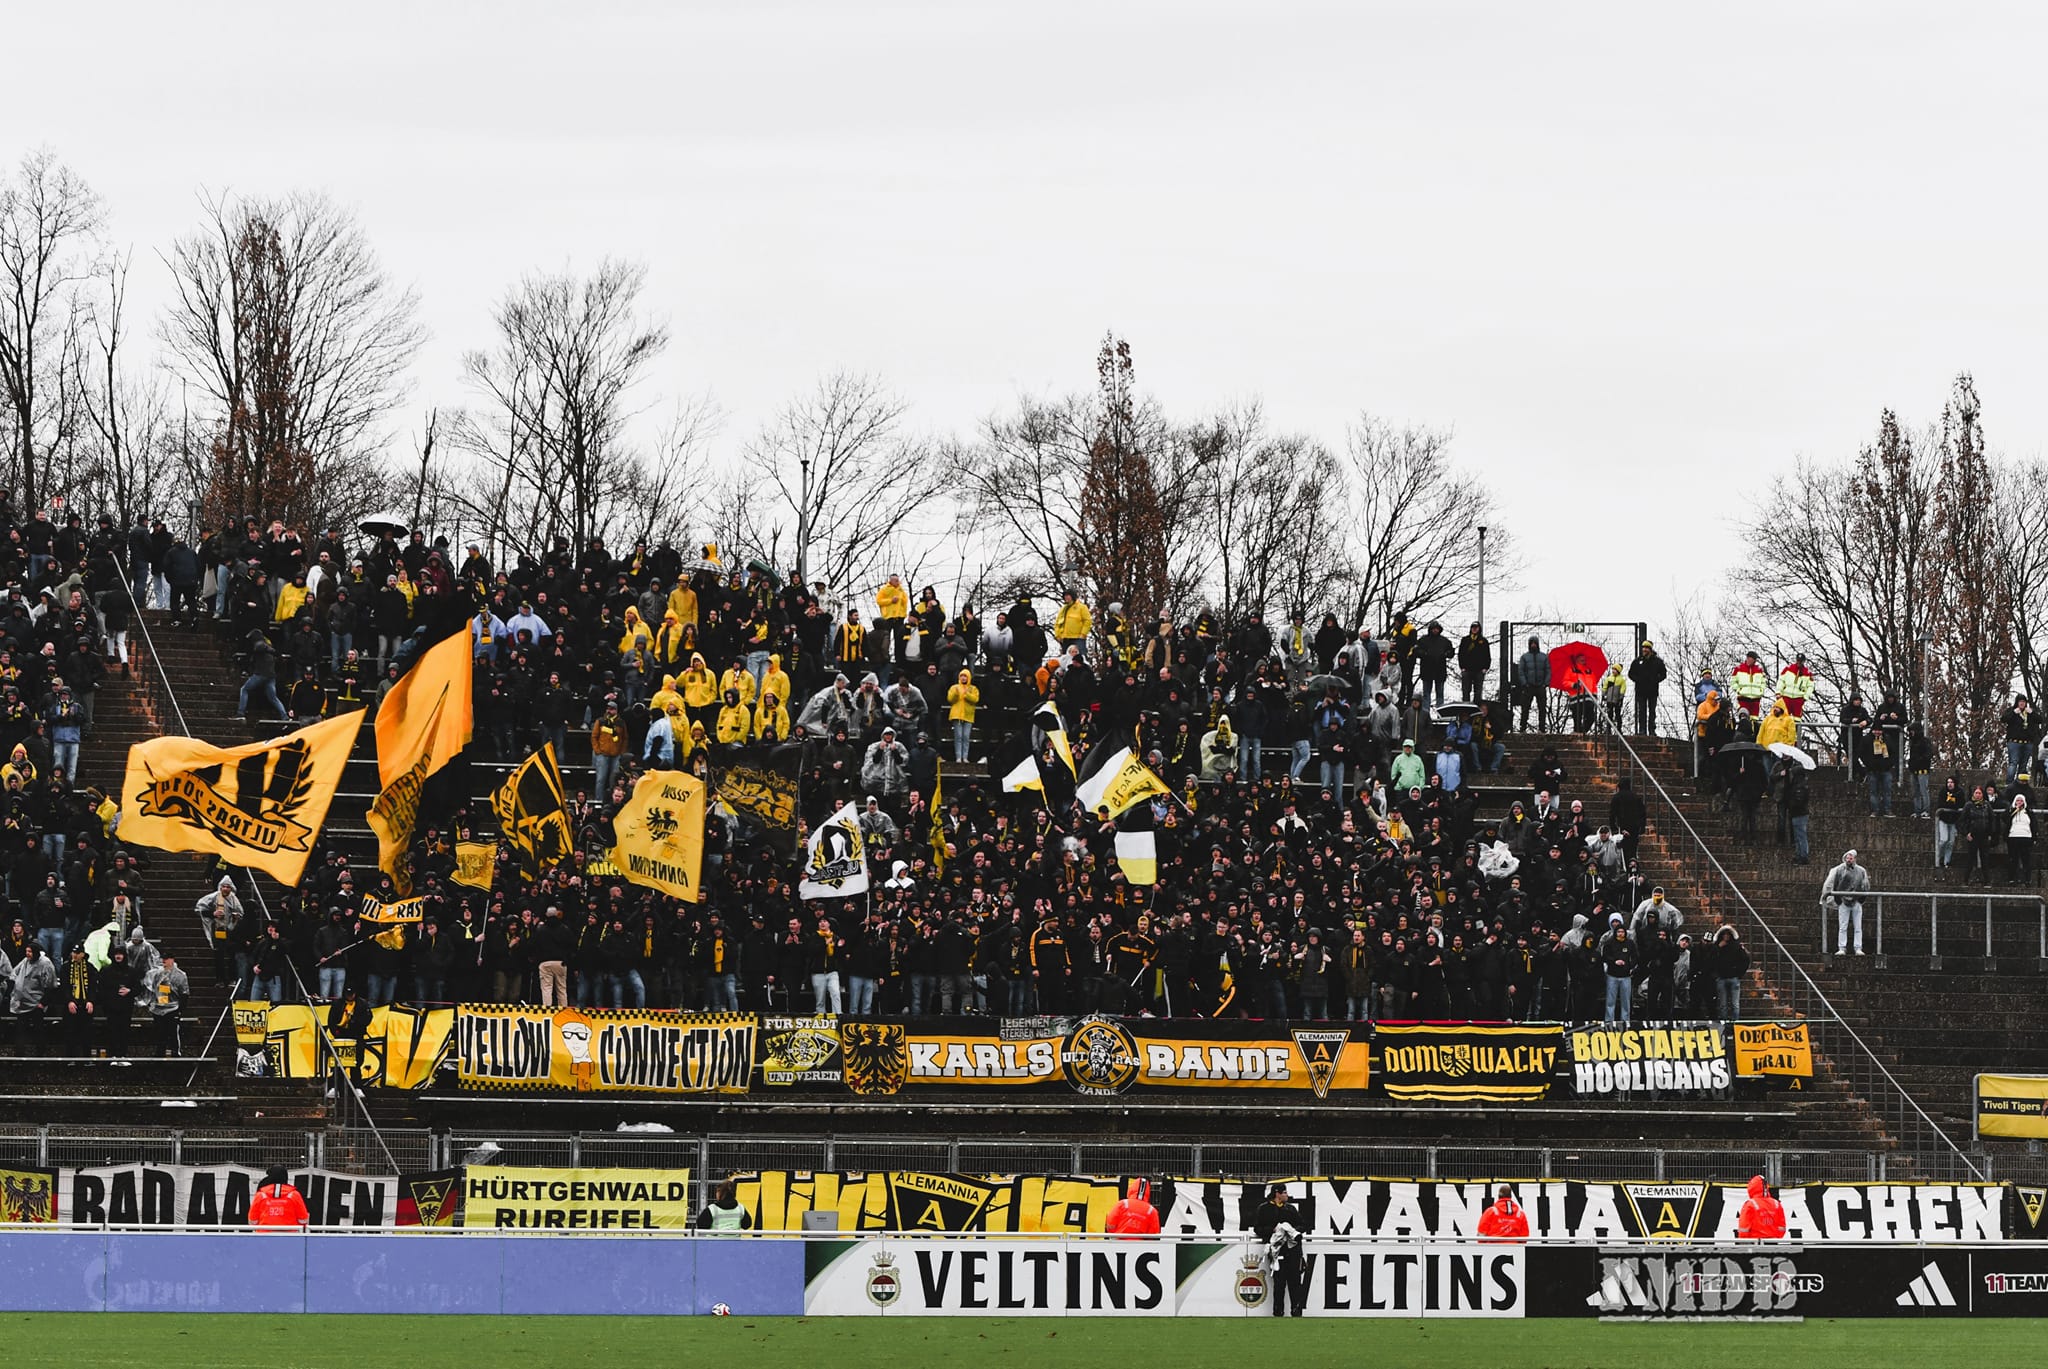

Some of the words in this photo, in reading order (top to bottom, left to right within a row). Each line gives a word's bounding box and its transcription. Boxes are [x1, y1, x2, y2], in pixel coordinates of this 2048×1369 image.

[765, 1015, 793, 1030] FÜR
[795, 1018, 838, 1030] STADT
[1000, 1017, 1049, 1028] LEGENDEN
[1740, 1028, 1804, 1043] OECHER
[1298, 1033, 1344, 1041] ALEMANNIA
[1572, 1029, 1726, 1062] BOXSTAFFEL
[460, 1014, 550, 1078] YELLOW
[600, 1023, 753, 1089] CONNECTION
[909, 1042, 1055, 1078] KARLS
[1147, 1044, 1290, 1080] BANDE
[1314, 1043, 1329, 1061] A
[768, 1071, 795, 1082] UND
[796, 1071, 842, 1081] VEREIN
[1574, 1058, 1730, 1093] HOOLIGANS
[1077, 1083, 1120, 1096] BANDE
[1983, 1100, 2009, 1110] Tivoli
[2010, 1101, 2041, 1112] Tigers
[469, 1175, 685, 1202] HÜRTGENWALD
[896, 1173, 980, 1203] ALEMANNIA
[1632, 1187, 1698, 1196] ALEMANNIA
[186, 1171, 386, 1233] AAHEN
[918, 1200, 944, 1230] A
[1161, 1182, 1629, 1243] ALMANNIA
[1656, 1202, 1681, 1229] A
[495, 1208, 660, 1233] RUREIFEL
[914, 1250, 1161, 1310] VELTINS
